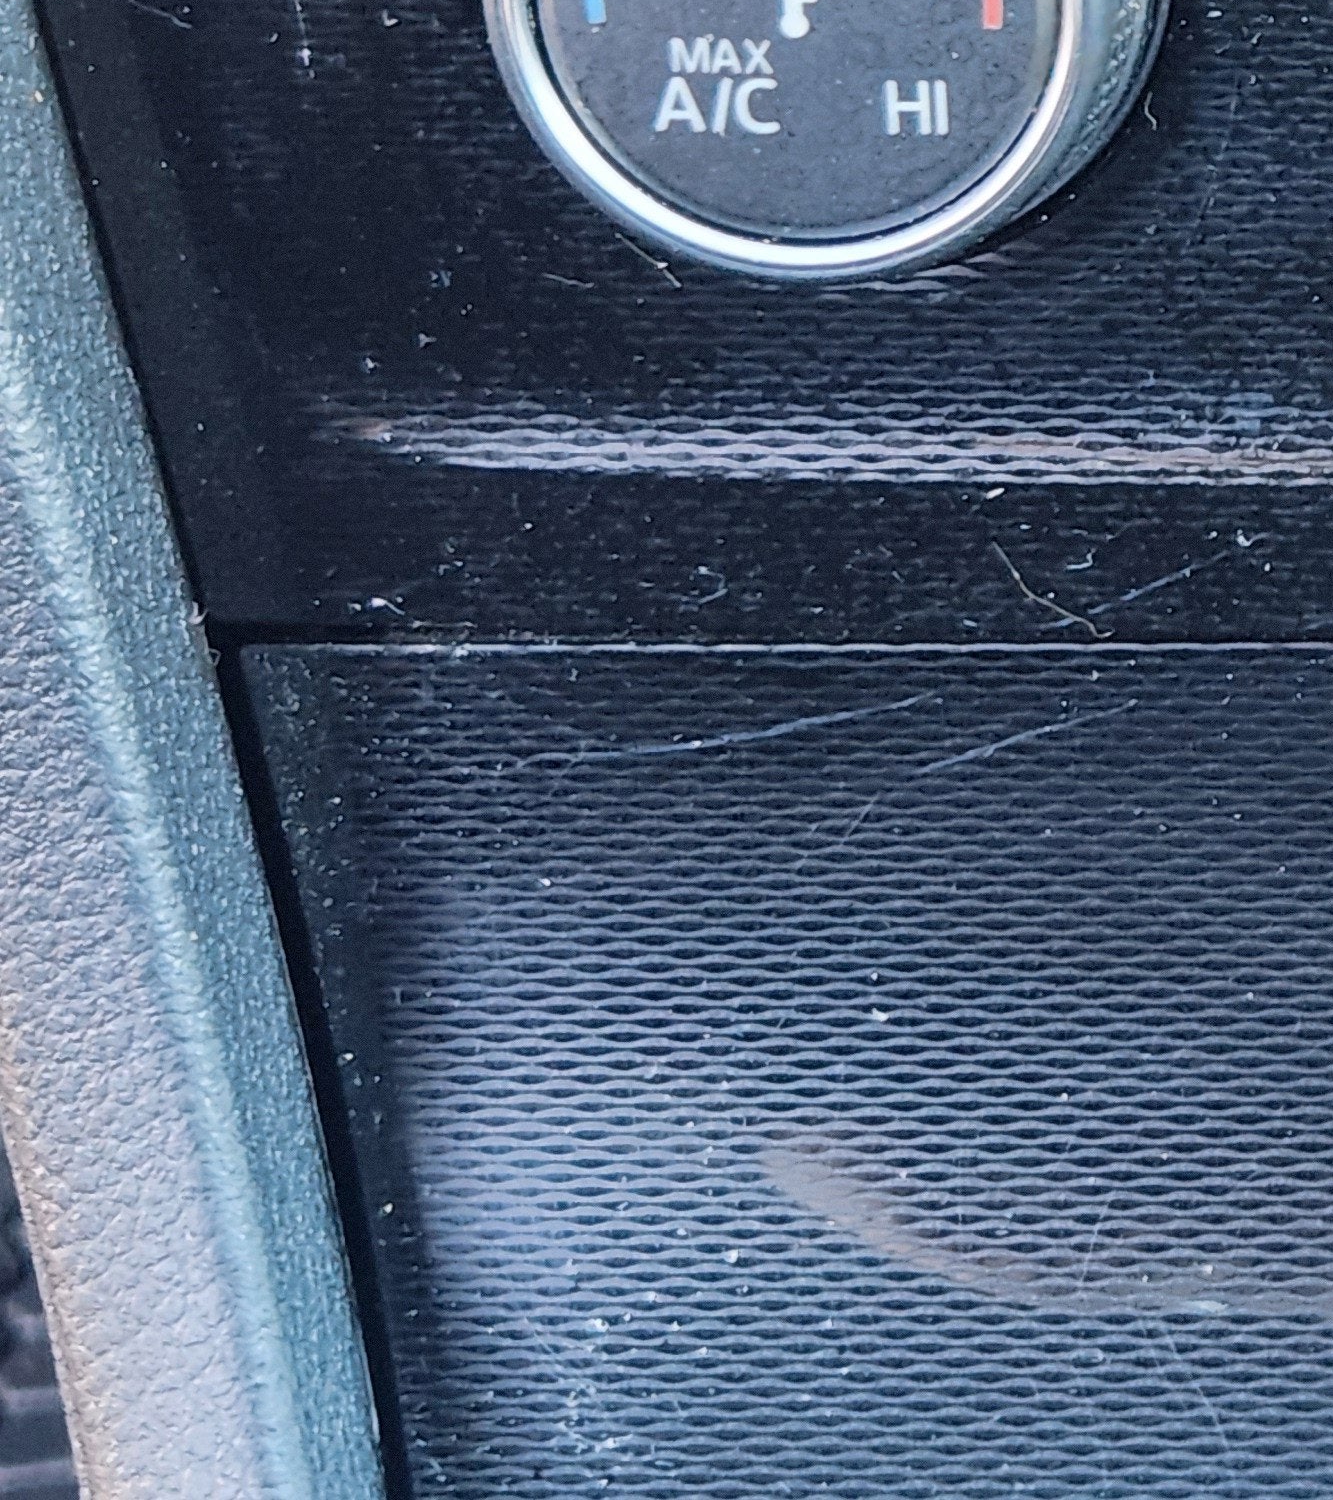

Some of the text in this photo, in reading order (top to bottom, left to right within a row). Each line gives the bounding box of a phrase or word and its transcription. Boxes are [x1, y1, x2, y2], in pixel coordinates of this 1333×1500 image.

[668, 36, 774, 75] MAX
[653, 76, 781, 136] A/C
[882, 78, 950, 136] HI
